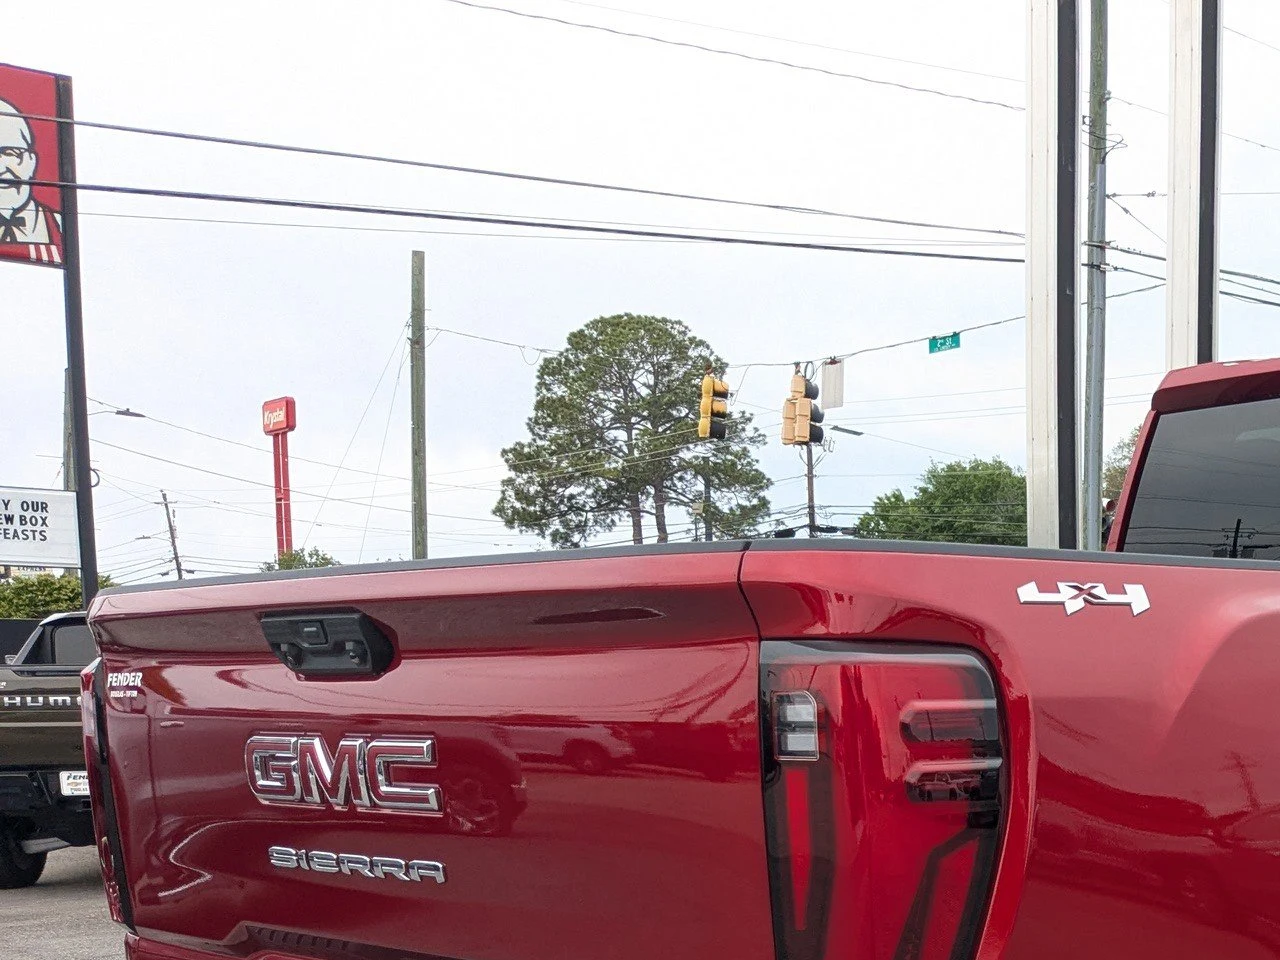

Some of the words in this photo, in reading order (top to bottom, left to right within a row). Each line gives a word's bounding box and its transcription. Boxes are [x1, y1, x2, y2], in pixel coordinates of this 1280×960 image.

[264, 407, 285, 428] Krystal
[20, 500, 49, 513] OUR
[19, 515, 49, 527] BOX
[107, 672, 143, 687] FENDER
[245, 734, 441, 813] GMC
[267, 845, 447, 884] SIERRA
